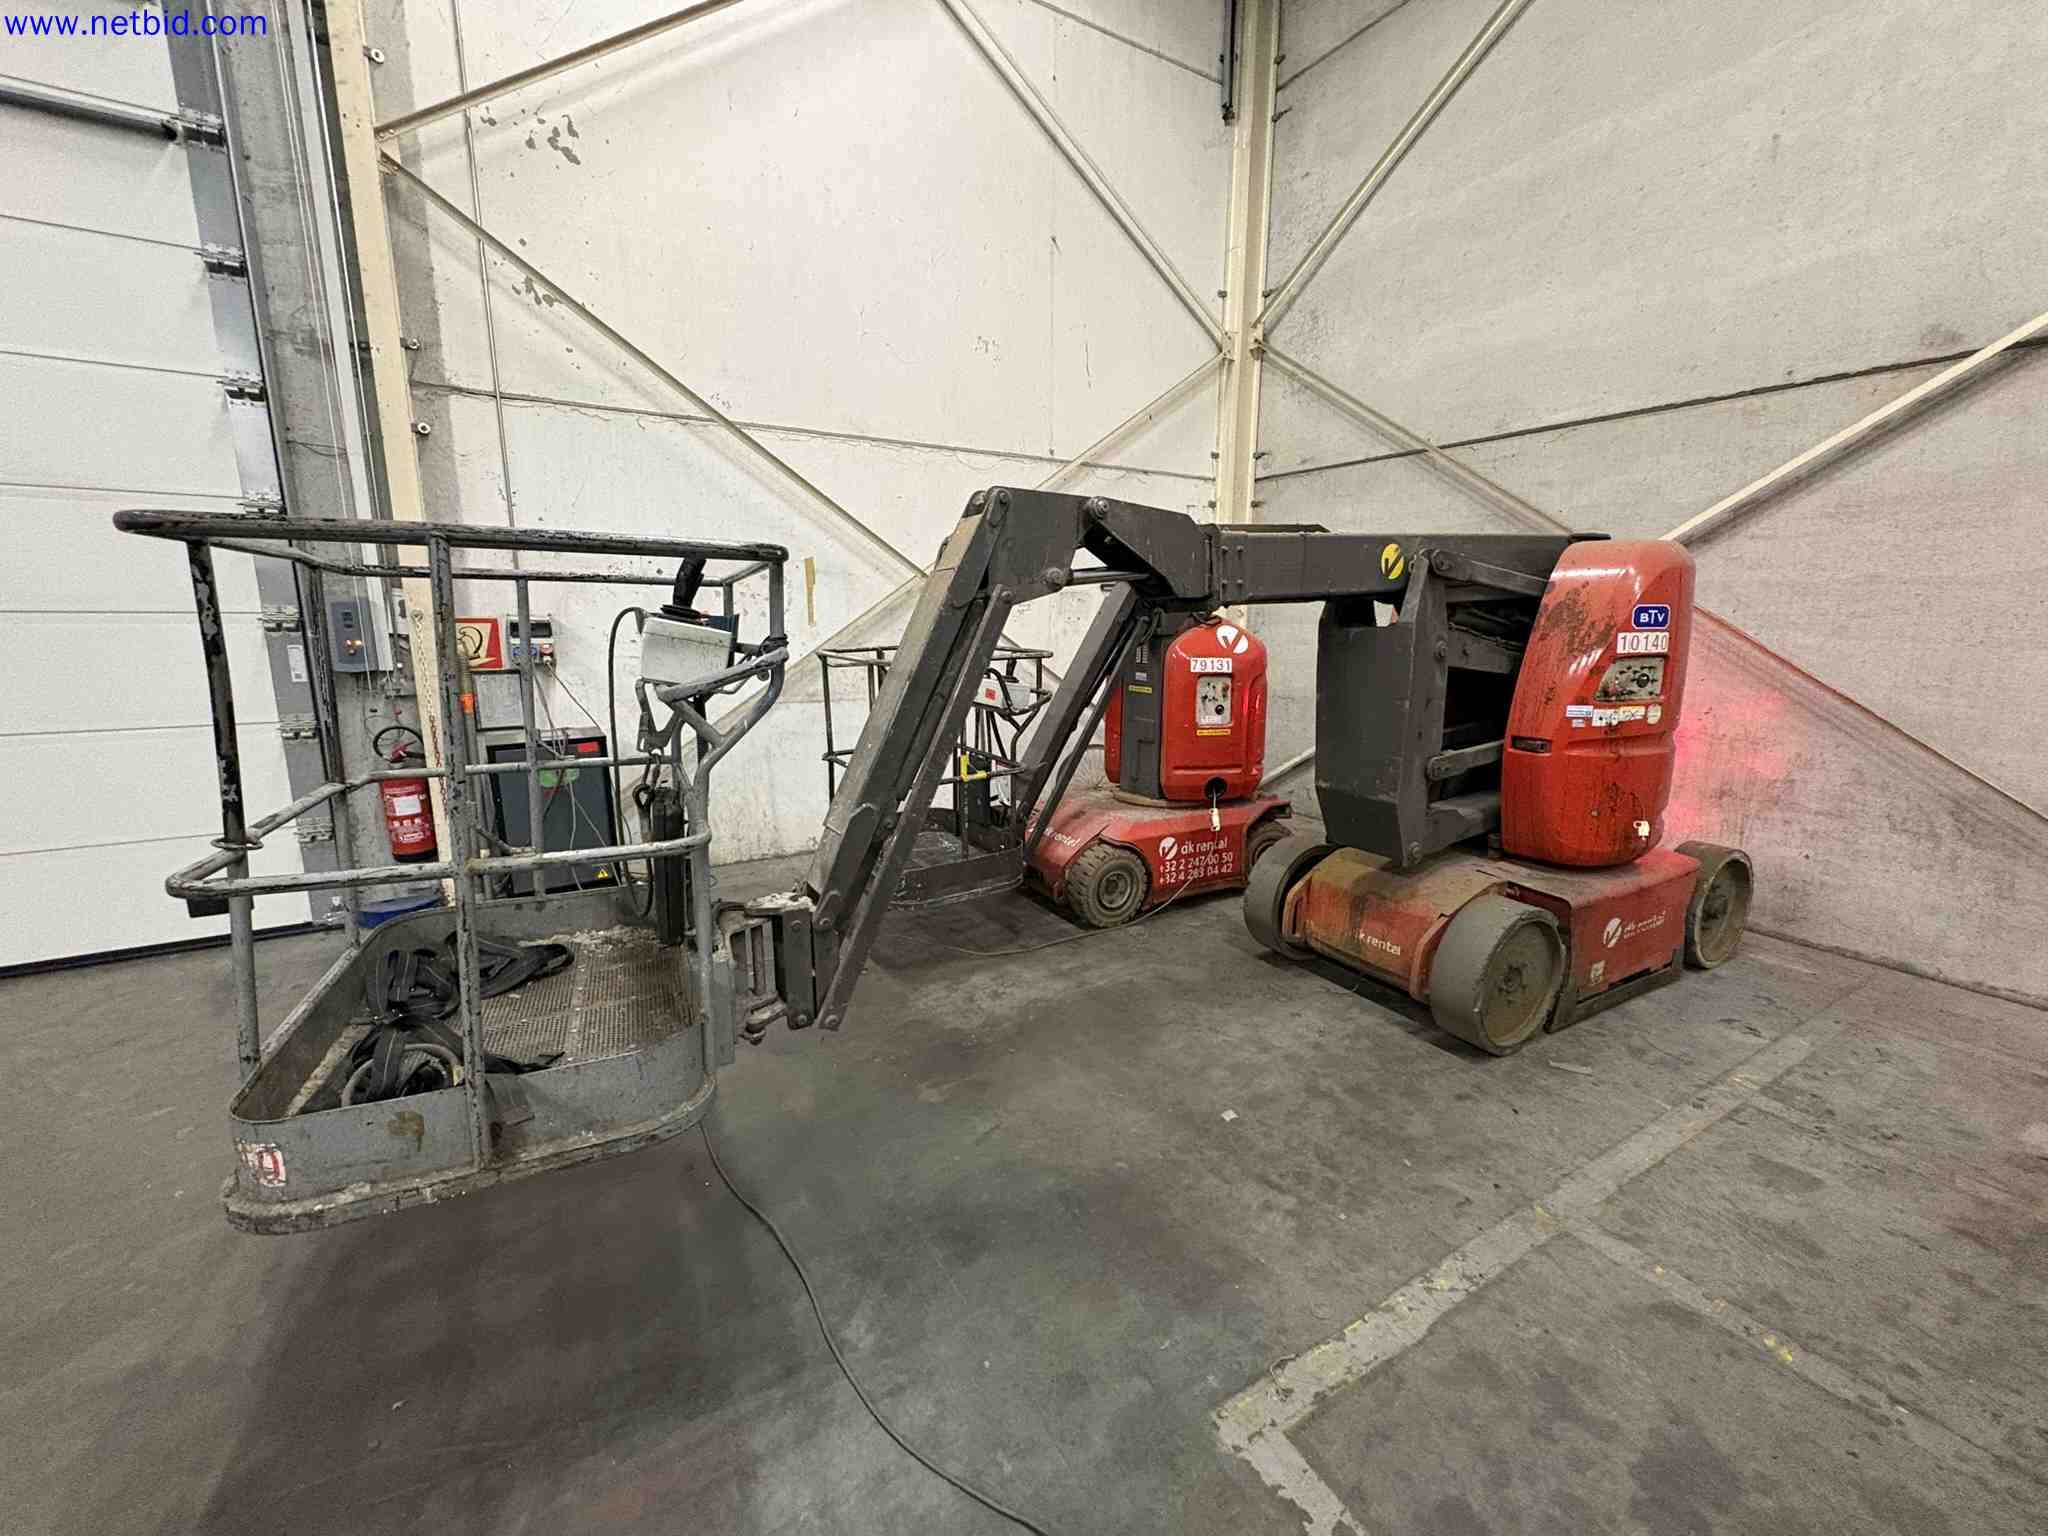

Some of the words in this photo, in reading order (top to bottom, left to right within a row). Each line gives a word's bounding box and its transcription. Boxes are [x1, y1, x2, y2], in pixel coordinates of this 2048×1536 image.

[1620, 634, 1668, 651] 10140
[1191, 659, 1231, 671] 79131
[1222, 851, 1233, 863] 50
[1221, 862, 1233, 873] 42
[1367, 935, 1401, 956] rental
